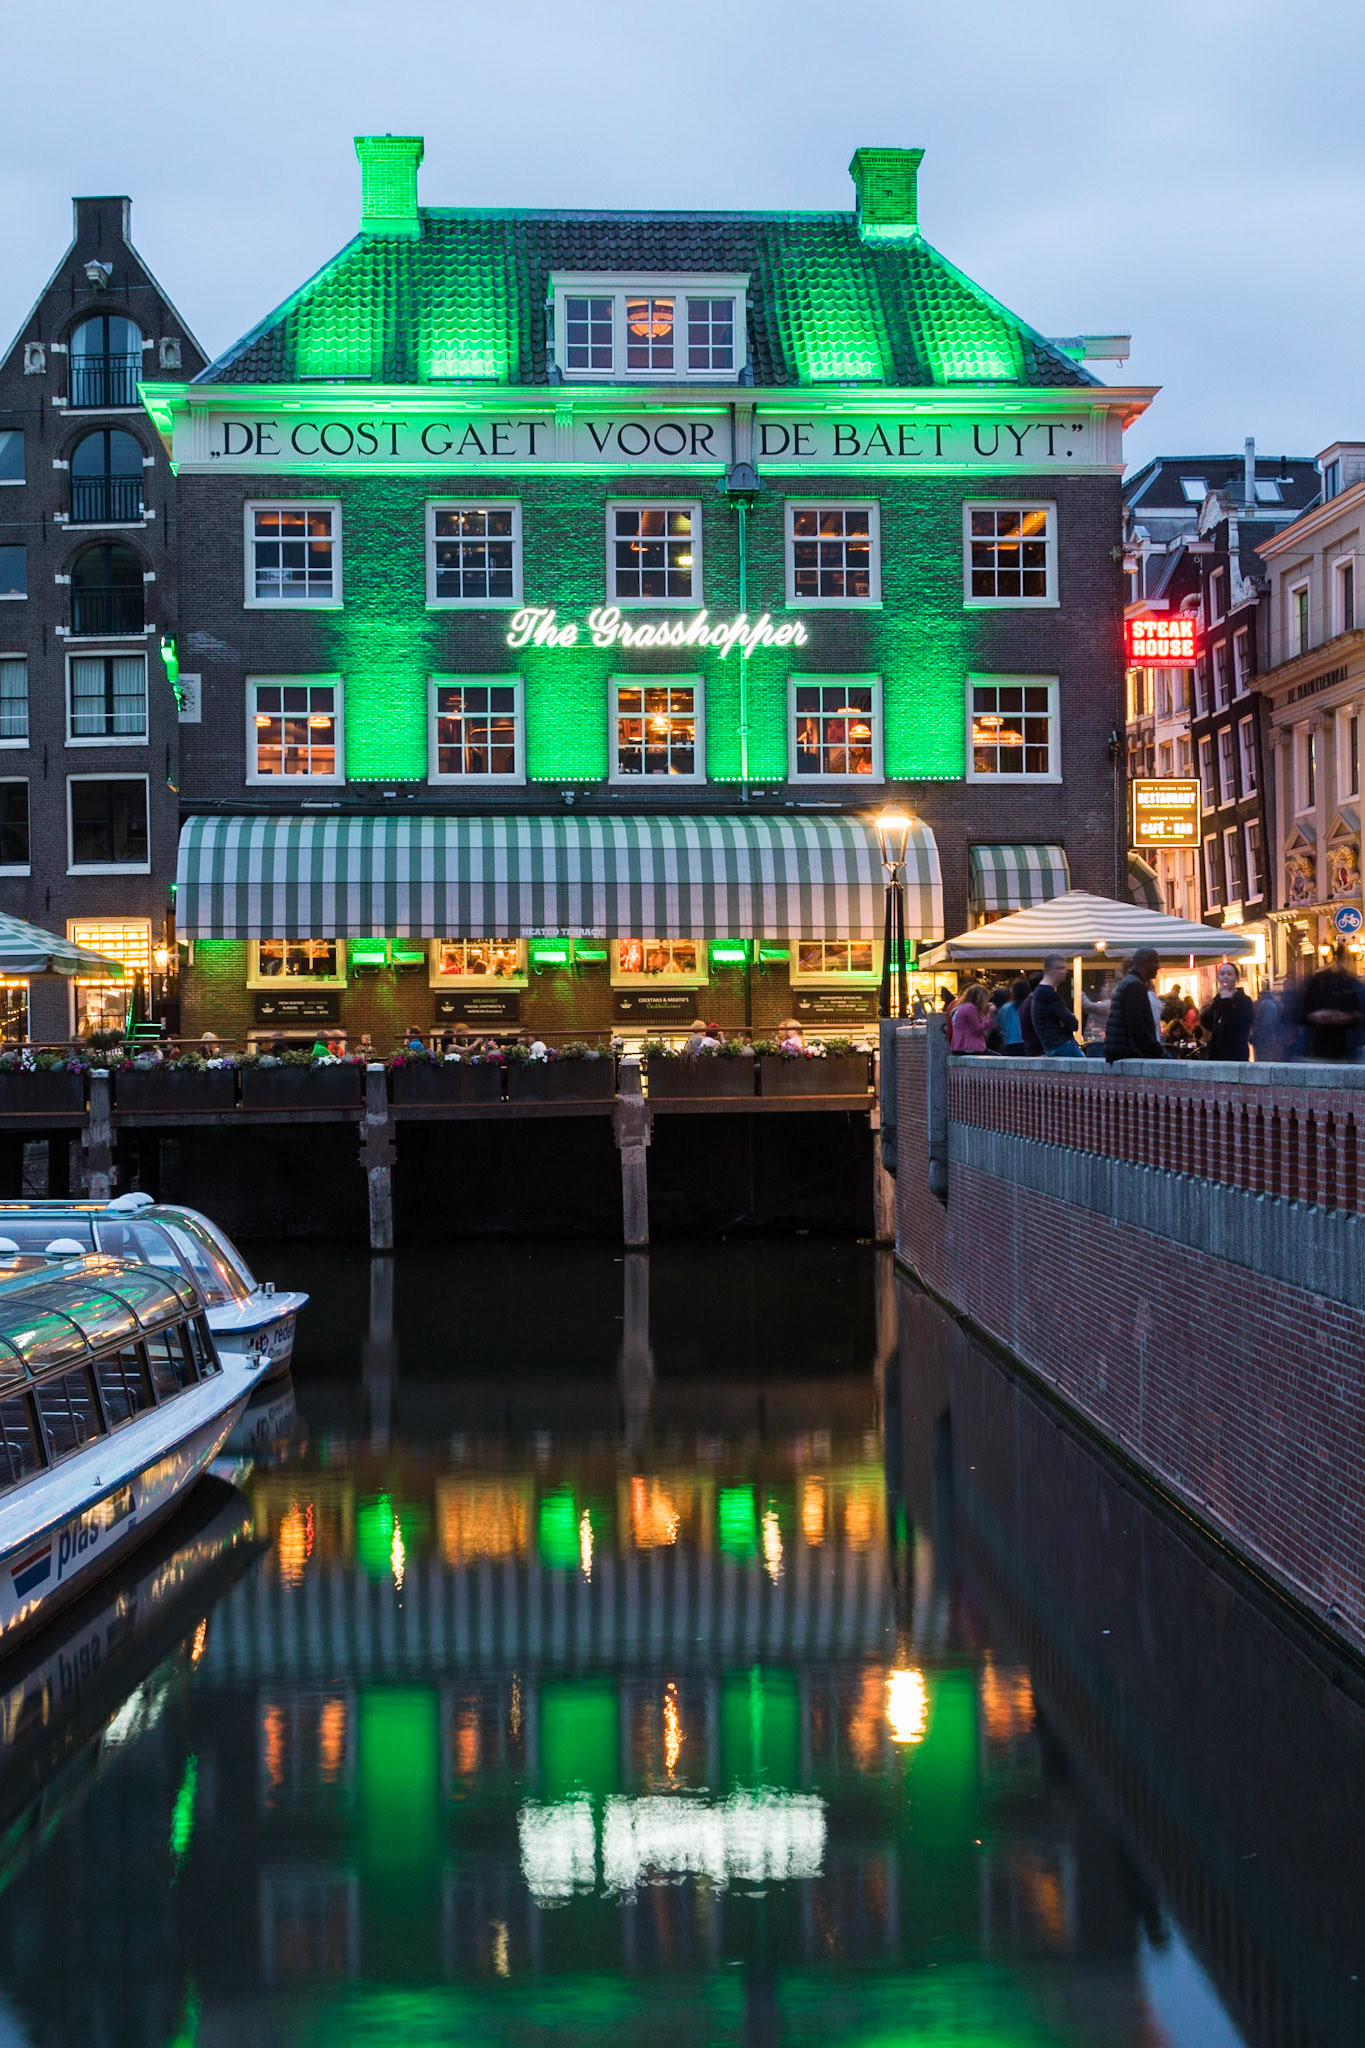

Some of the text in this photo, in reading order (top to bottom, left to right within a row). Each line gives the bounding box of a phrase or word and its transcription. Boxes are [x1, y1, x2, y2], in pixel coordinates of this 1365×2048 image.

[291, 421, 408, 456] COST
[421, 421, 548, 456] GAET
[584, 422, 718, 456] VOOR
[759, 423, 818, 456] DE
[833, 423, 953, 457] BAET
[506, 606, 809, 659] The Grasshopper
[1131, 620, 1193, 638] STEAK
[1132, 639, 1194, 657] HOUSE
[1137, 792, 1197, 805] RESTAURANT
[1140, 821, 1165, 835] CAFÉ
[1173, 822, 1193, 835] BAR
[521, 928, 604, 936] HEATED TERRACE
[57, 1517, 99, 1581] plas
